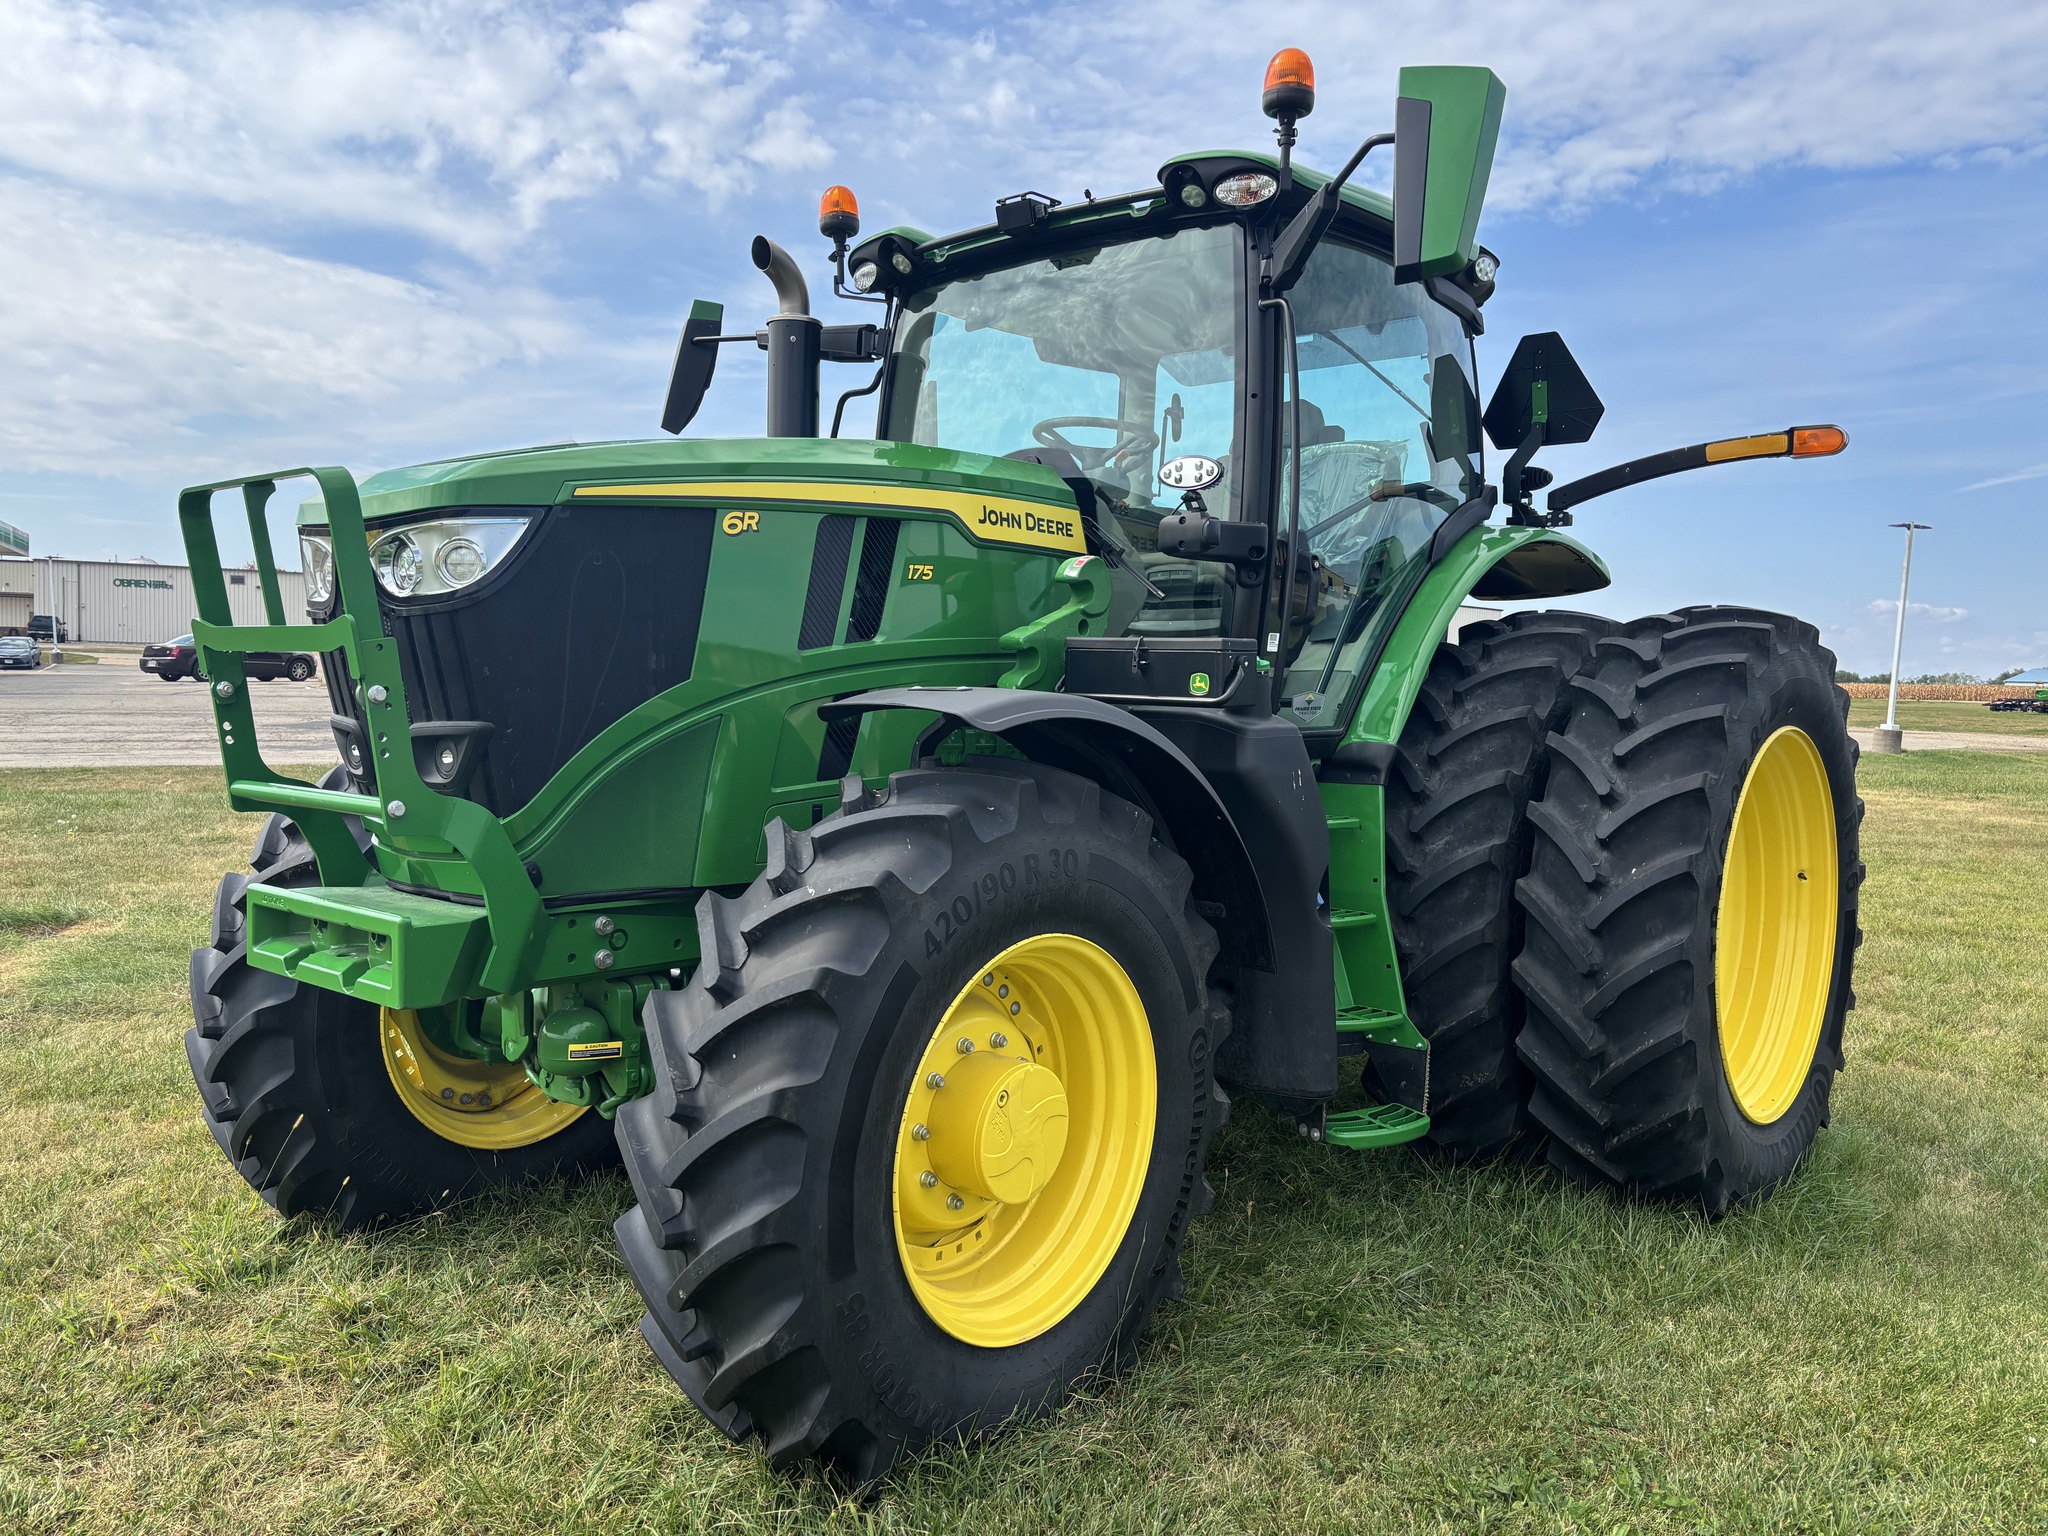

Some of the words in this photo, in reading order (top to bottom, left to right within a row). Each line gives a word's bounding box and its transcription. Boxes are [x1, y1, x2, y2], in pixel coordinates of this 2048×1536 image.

[721, 510, 761, 537] 6R
[978, 504, 1022, 530] JOHN
[1025, 511, 1074, 538] DEERE
[906, 564, 934, 582] 175
[924, 862, 1017, 961] 420/90
[1022, 852, 1043, 886] R
[1048, 848, 1080, 879] 30
